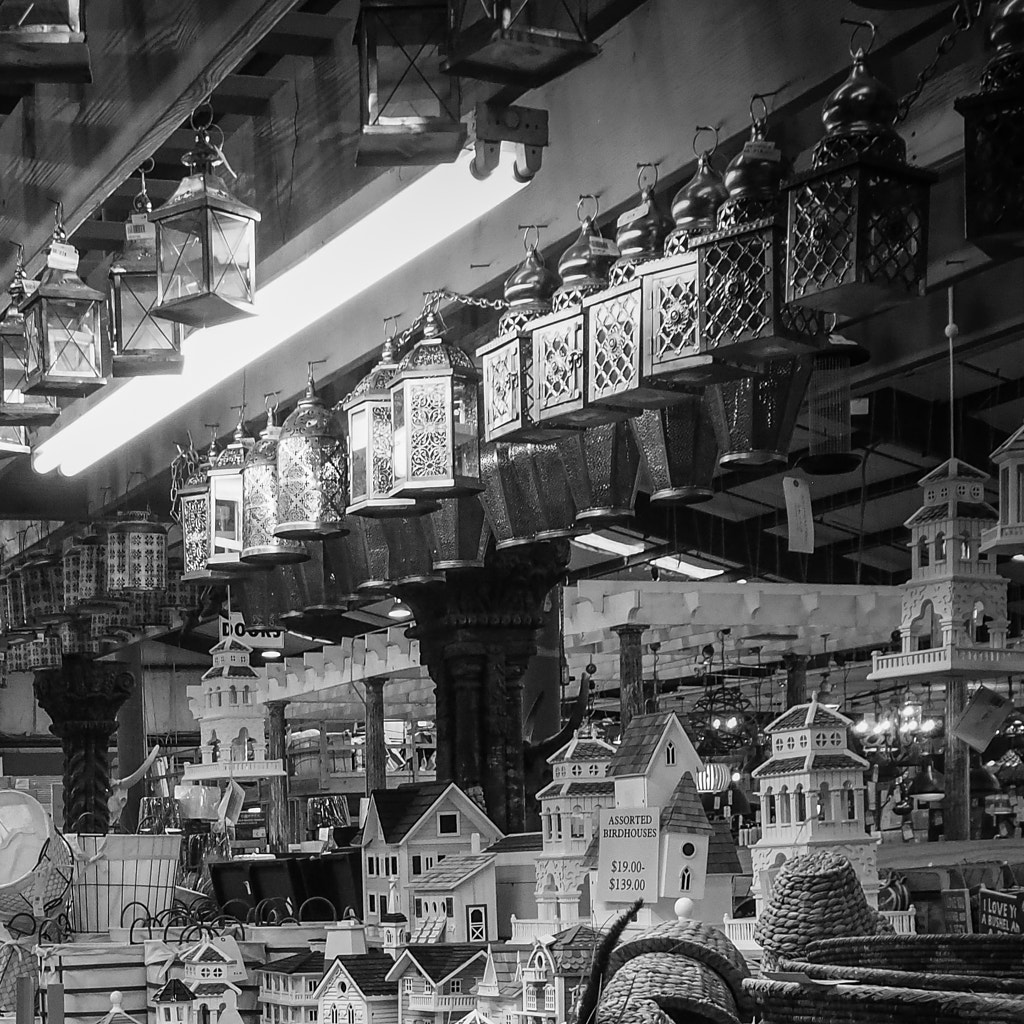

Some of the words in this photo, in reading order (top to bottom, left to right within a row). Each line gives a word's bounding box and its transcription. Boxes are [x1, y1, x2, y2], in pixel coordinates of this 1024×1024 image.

[608, 815, 653, 825] ASSORTED
[603, 828, 657, 838] BIRDHOUSES
[611, 860, 645, 873] $19.00-
[609, 878, 646, 891] $139.00
[988, 898, 1007, 917] LOVE
